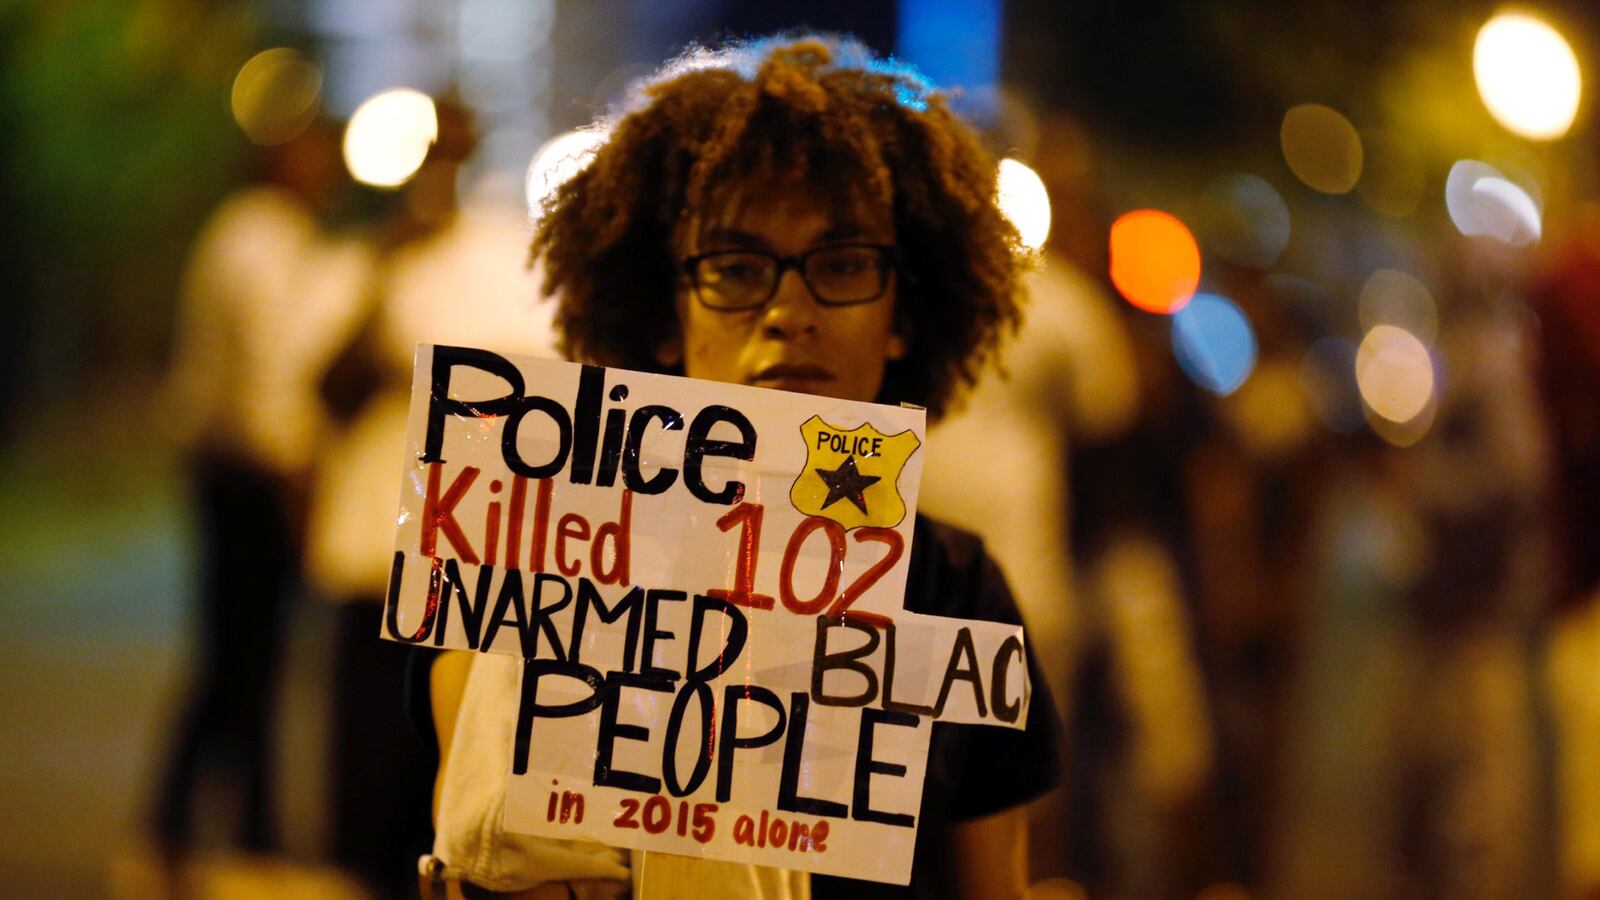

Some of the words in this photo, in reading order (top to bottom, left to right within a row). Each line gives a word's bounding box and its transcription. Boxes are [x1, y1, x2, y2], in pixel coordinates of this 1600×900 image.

[419, 345, 757, 505] Police
[816, 431, 883, 457] POLICE
[420, 462, 633, 588] Killed
[706, 501, 905, 628] 102
[387, 550, 748, 683] UNARMED
[810, 614, 1024, 724] BLAC
[512, 658, 919, 828] PEOPLE
[546, 779, 585, 825] in
[613, 794, 719, 844] 2015
[732, 809, 831, 854] alone
